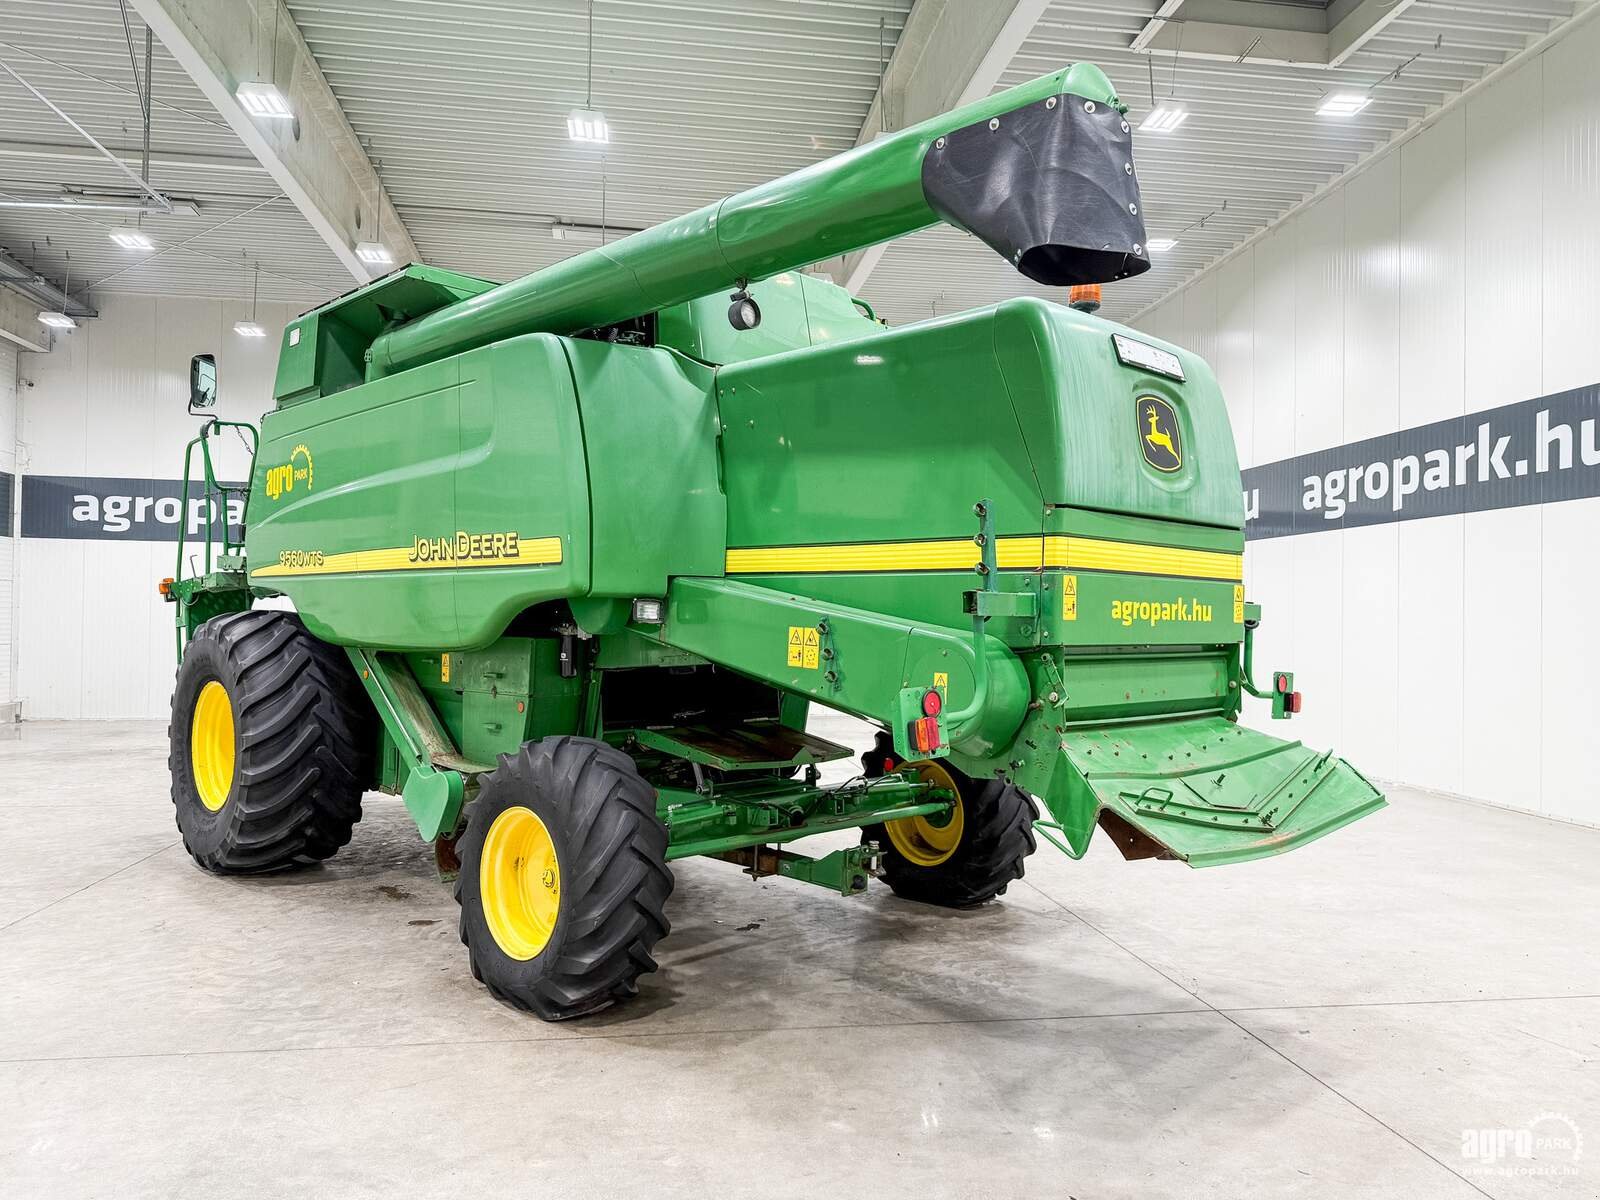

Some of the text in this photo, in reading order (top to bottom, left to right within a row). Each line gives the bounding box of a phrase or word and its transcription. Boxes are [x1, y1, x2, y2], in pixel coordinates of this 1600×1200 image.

[266, 464, 308, 500] agro PARK
[409, 531, 519, 561] JOHN DEERE
[1111, 597, 1212, 627] agropark.hu
